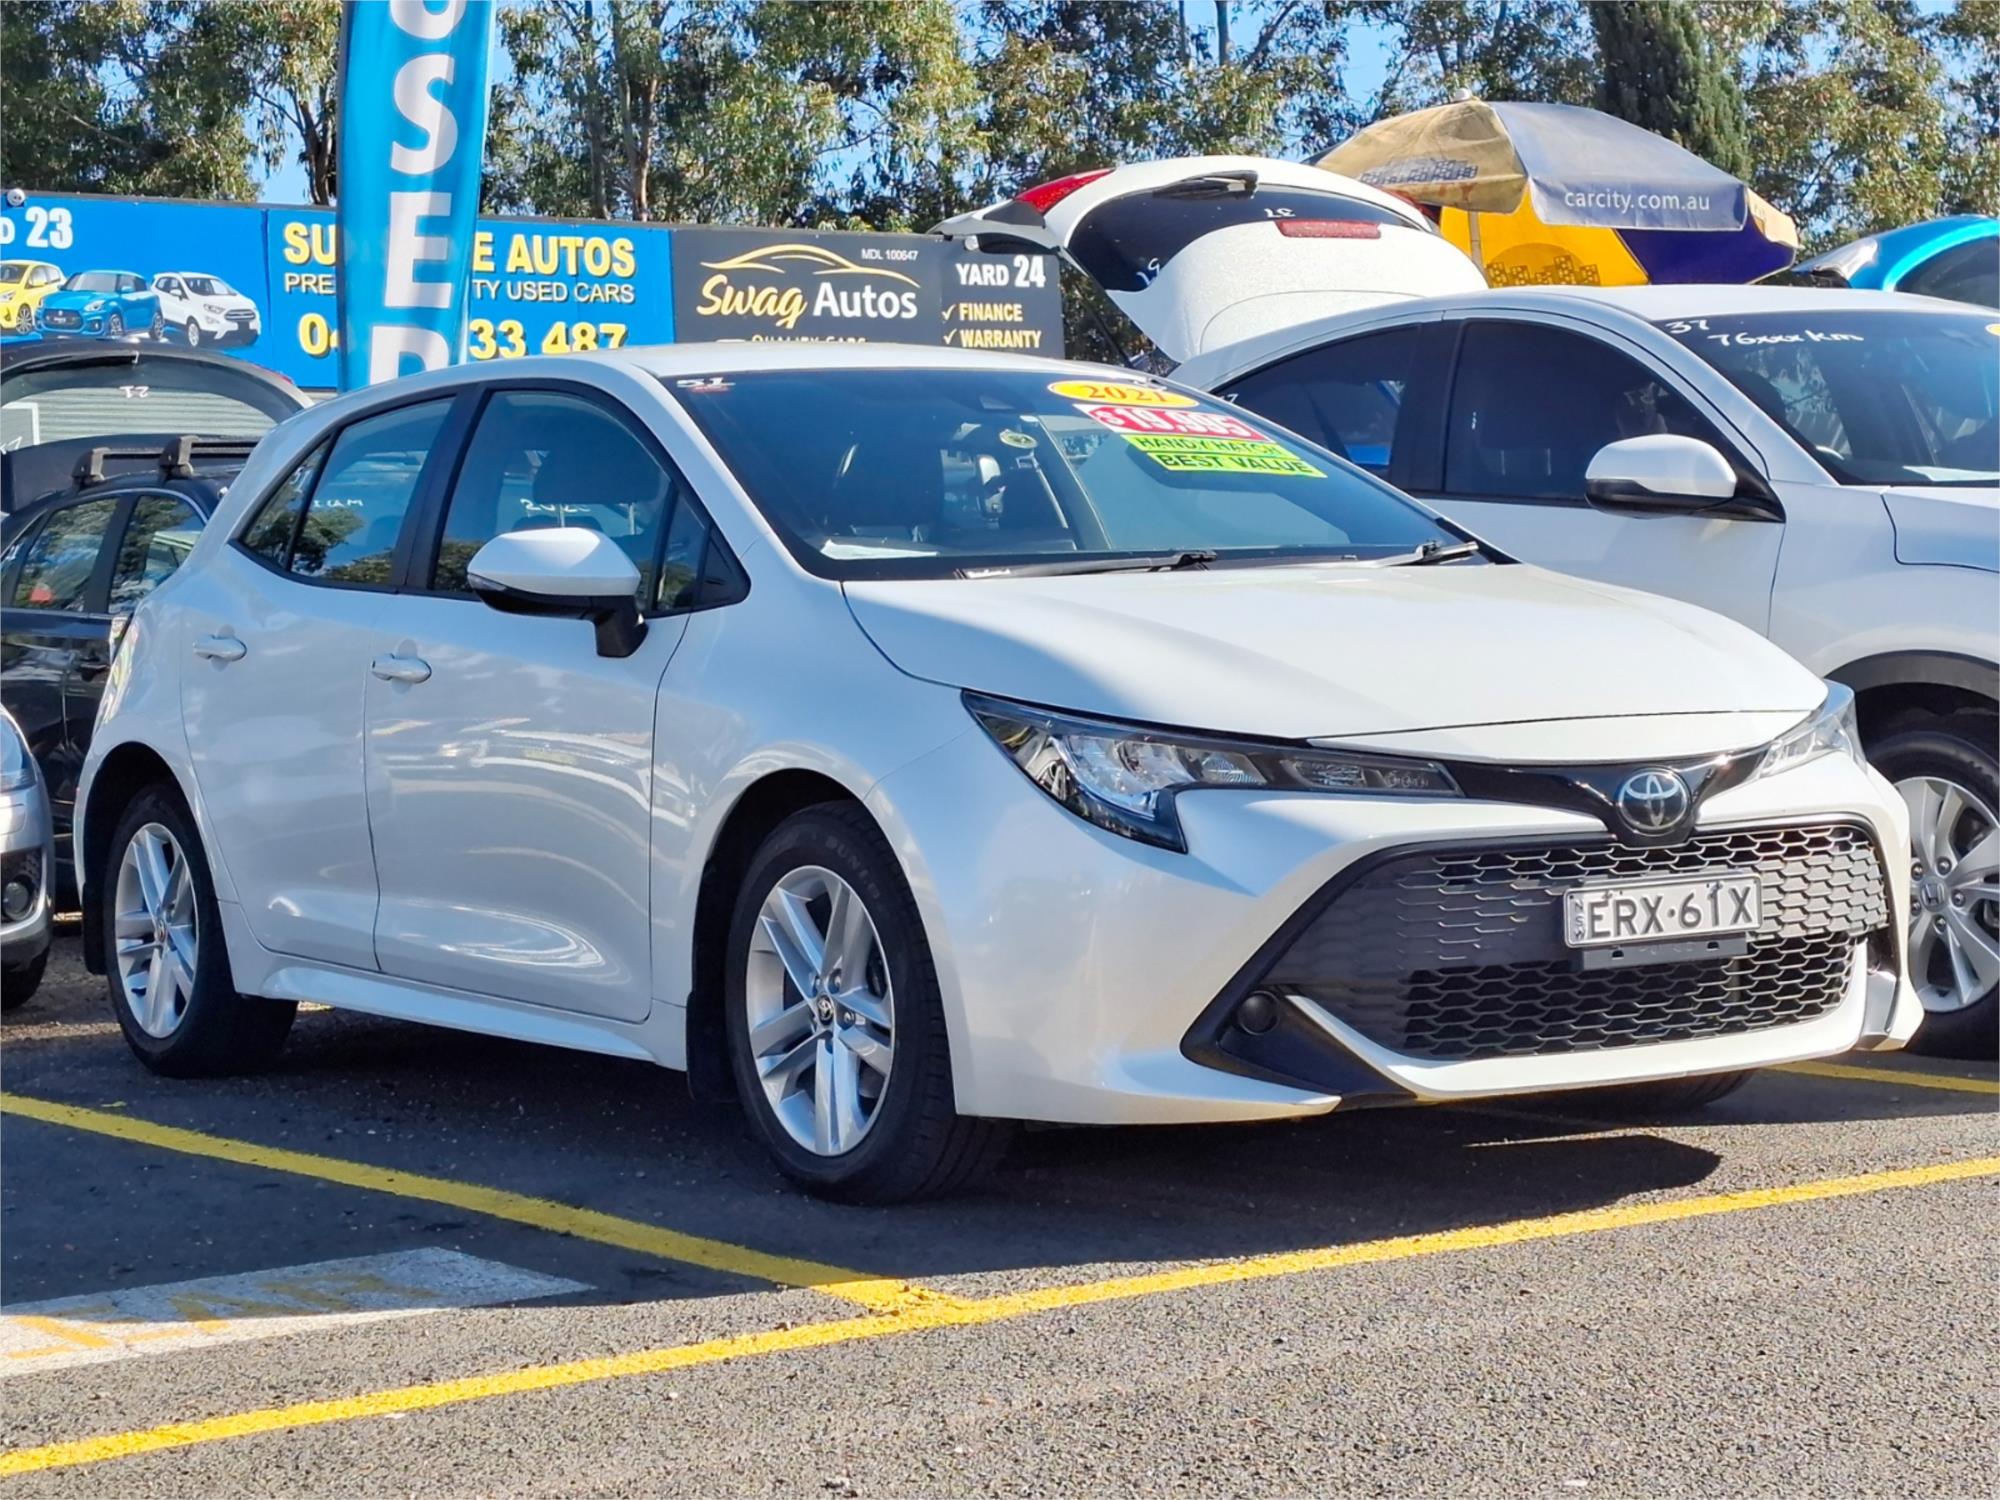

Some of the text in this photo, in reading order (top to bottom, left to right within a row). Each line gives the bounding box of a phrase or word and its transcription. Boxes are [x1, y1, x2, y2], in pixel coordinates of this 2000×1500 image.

[1564, 190, 1710, 214] carcity.com.au
[25, 206, 73, 249] 23
[506, 233, 637, 278] AUTOS
[861, 248, 883, 260] MDL
[955, 254, 1046, 288] YARD 24
[506, 281, 569, 302] USED
[573, 282, 636, 304] CARS
[696, 273, 918, 329] Swag Autos
[959, 302, 1023, 322] FINANCE
[541, 320, 628, 354] 487
[1665, 319, 1710, 334] 37
[960, 328, 1041, 348] WARRANTY
[1081, 384, 1168, 403] 2021
[1135, 436, 1207, 450] HANDY
[1156, 454, 1313, 473] BEST VALUE
